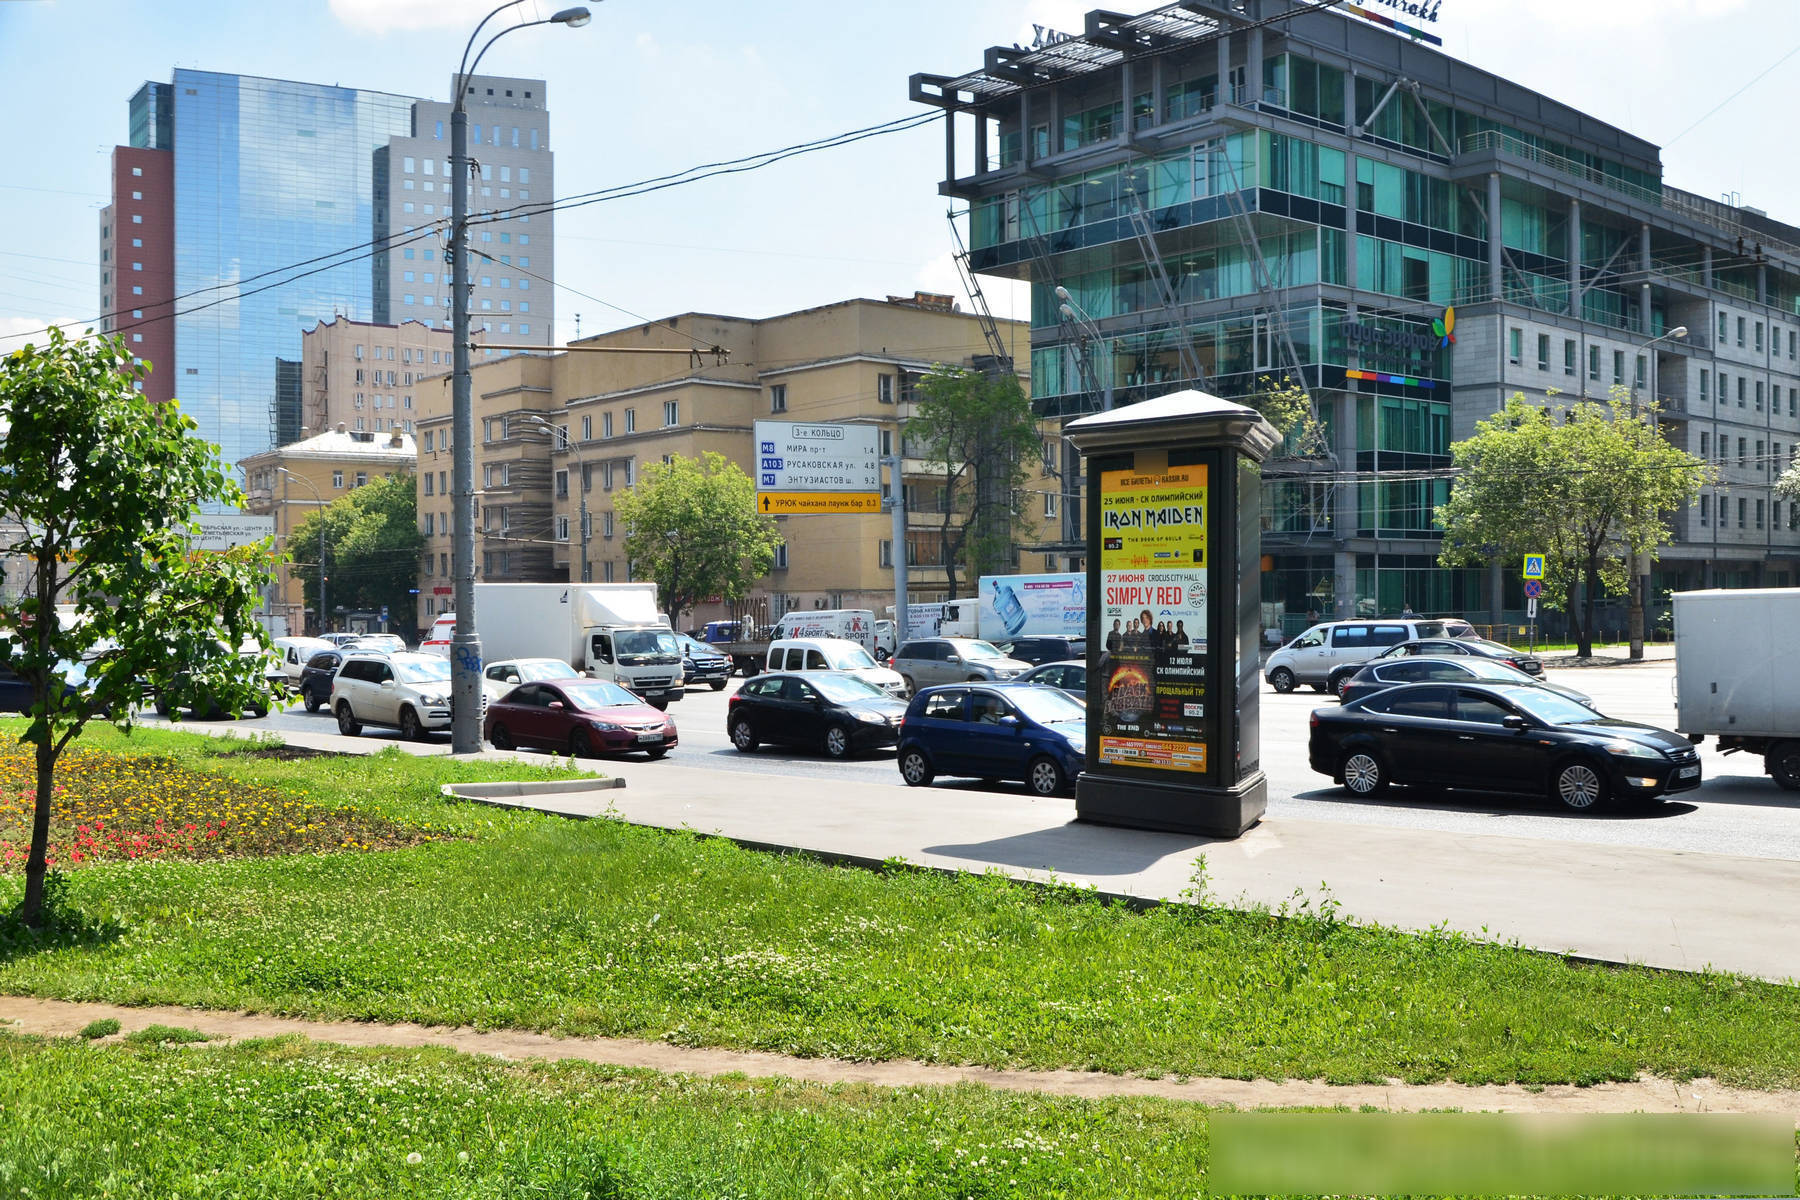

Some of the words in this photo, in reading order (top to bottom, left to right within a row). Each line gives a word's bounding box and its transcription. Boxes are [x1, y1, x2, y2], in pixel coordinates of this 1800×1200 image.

[795, 428, 808, 437] 3-е
[811, 430, 841, 438] КОЛЬЦО
[786, 445, 808, 453] МИРА
[864, 447, 874, 455] 1.4
[786, 461, 844, 470] РУСАКОВСКАЯ
[845, 463, 856, 471] ул.
[864, 462, 875, 470] 4.8
[787, 476, 844, 485] ЭНТУЗИАСТОВ
[864, 477, 875, 485] 9.2
[1104, 497, 1113, 505] 25
[1115, 496, 1135, 504] ИЮНЯ
[1140, 495, 1149, 503] СК
[1150, 490, 1204, 502] ОЛИМПИЙСКИЙ
[775, 499, 797, 508] УРЮК
[850, 499, 863, 508] бар
[1104, 509, 1142, 531] IRON
[1144, 505, 1204, 530] MAIDEN
[1119, 574, 1145, 582] ИЮНЯ
[1148, 574, 1170, 582] CROCUS
[1171, 573, 1183, 582] CITY
[1107, 587, 1153, 605] SIMPLY
[1157, 587, 1182, 605] RED
[1176, 657, 1193, 665] ИЮЛЯ
[1165, 667, 1205, 676] ОЛИМПИЙСКИЙ
[1156, 686, 1193, 696] ПРОЩАЛЬНЫЙ
[1195, 688, 1205, 696] ТУР
